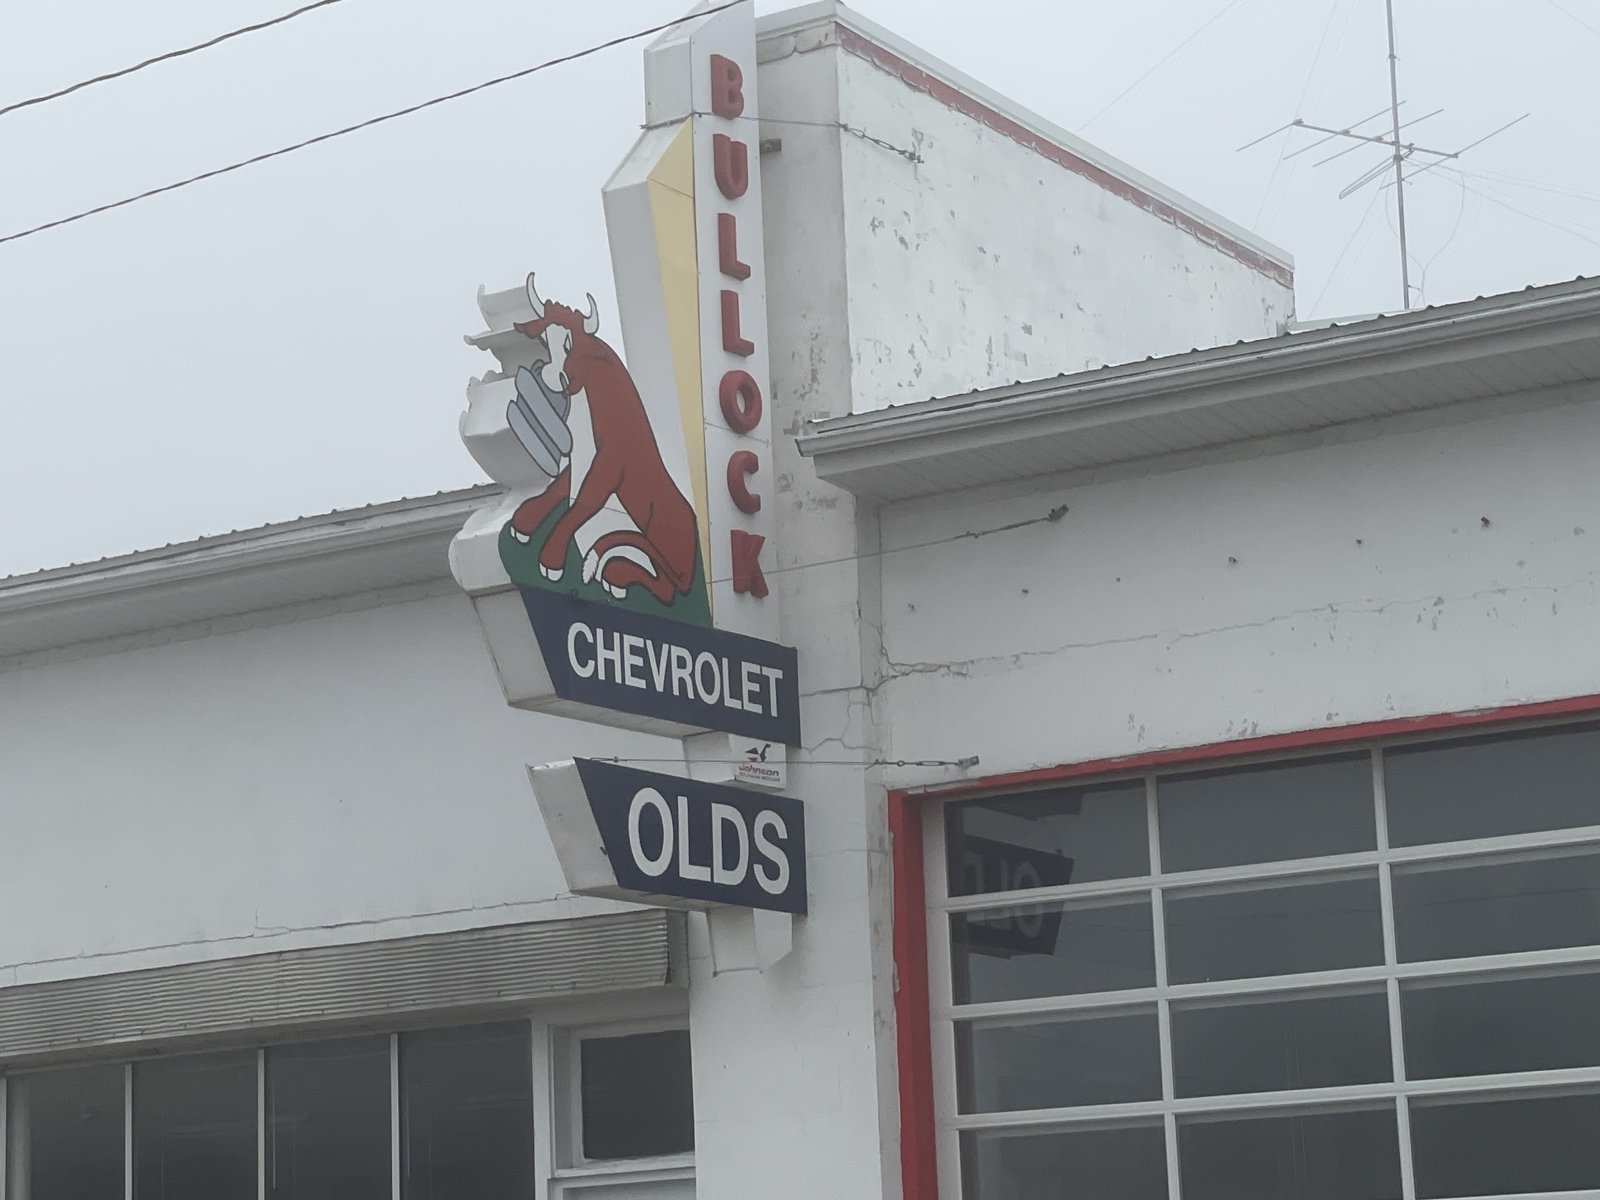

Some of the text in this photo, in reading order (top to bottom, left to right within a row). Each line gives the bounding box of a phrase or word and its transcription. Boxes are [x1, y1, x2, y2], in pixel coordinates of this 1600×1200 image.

[710, 53, 769, 599] BULLOCK
[567, 622, 783, 717] CHEVROLET
[739, 764, 779, 776] Johnson
[628, 787, 790, 894] OLDS
